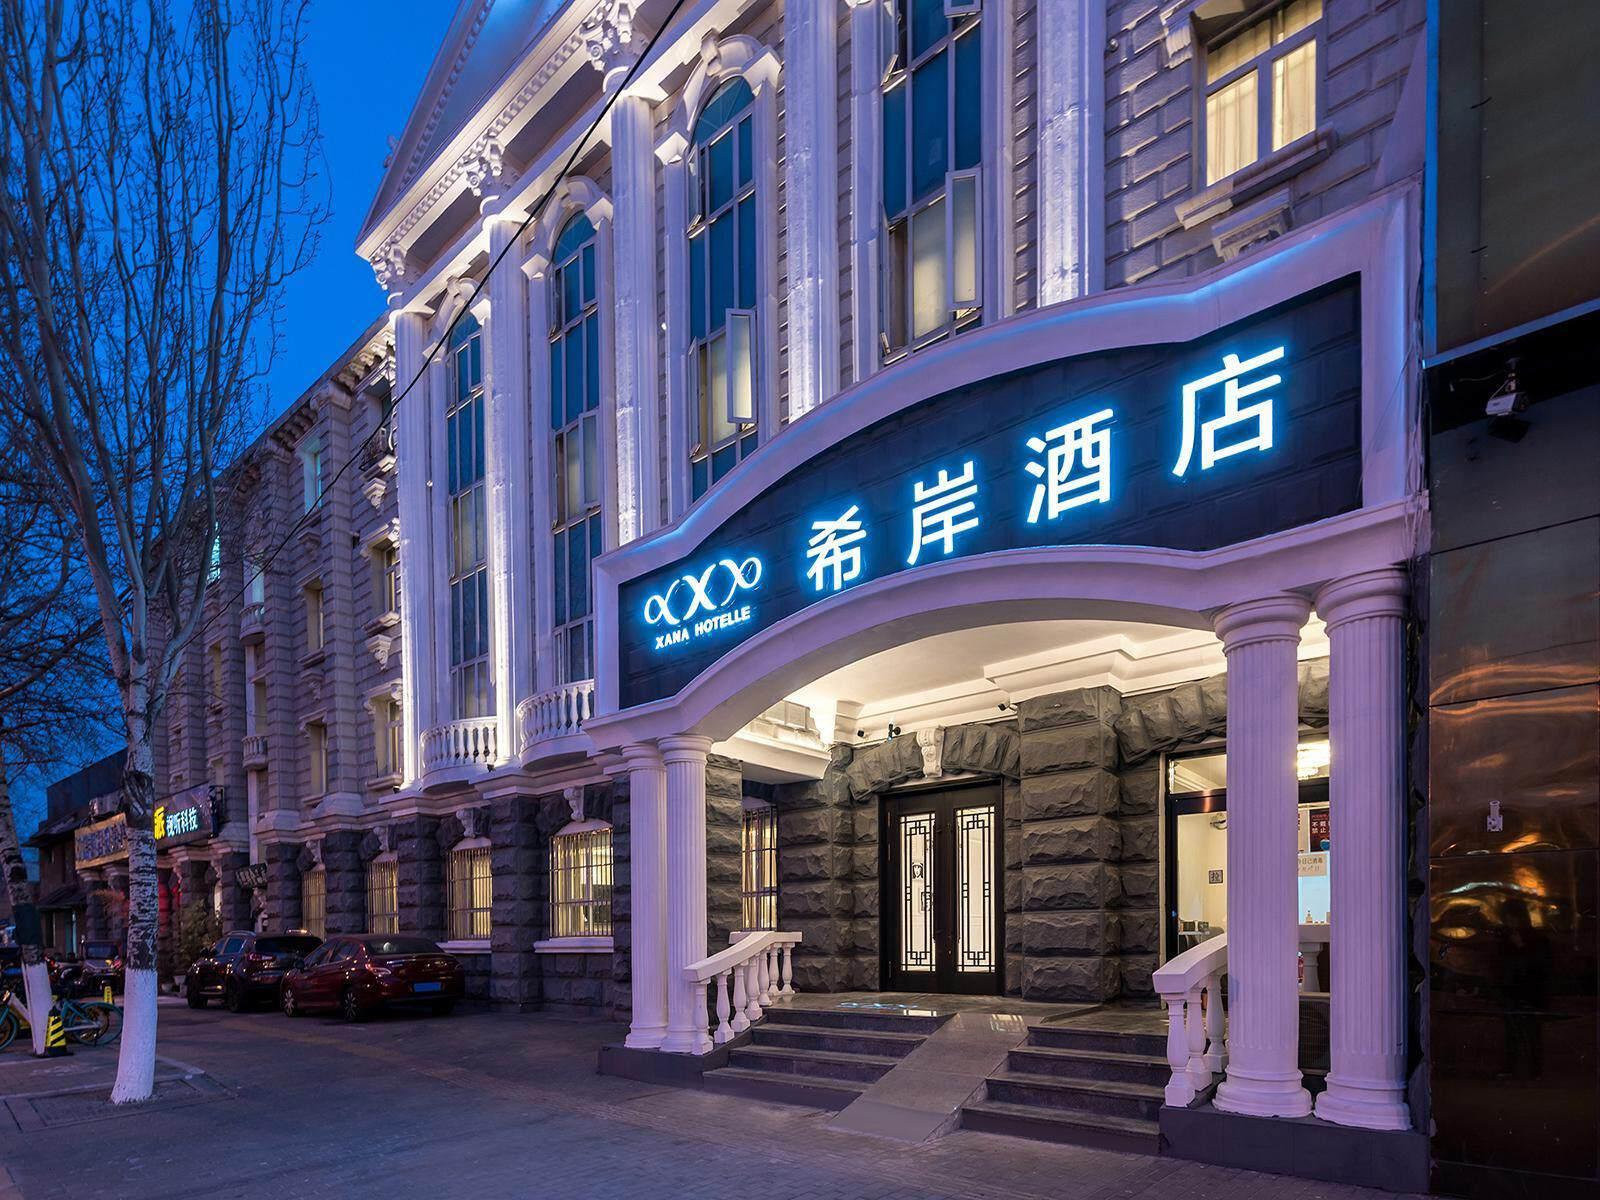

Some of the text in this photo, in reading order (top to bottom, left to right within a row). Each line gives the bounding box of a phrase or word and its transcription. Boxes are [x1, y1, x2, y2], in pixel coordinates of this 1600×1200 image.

[806, 346, 1285, 591] 希岸酒店
[654, 606, 751, 650] XANA HOTELLE
